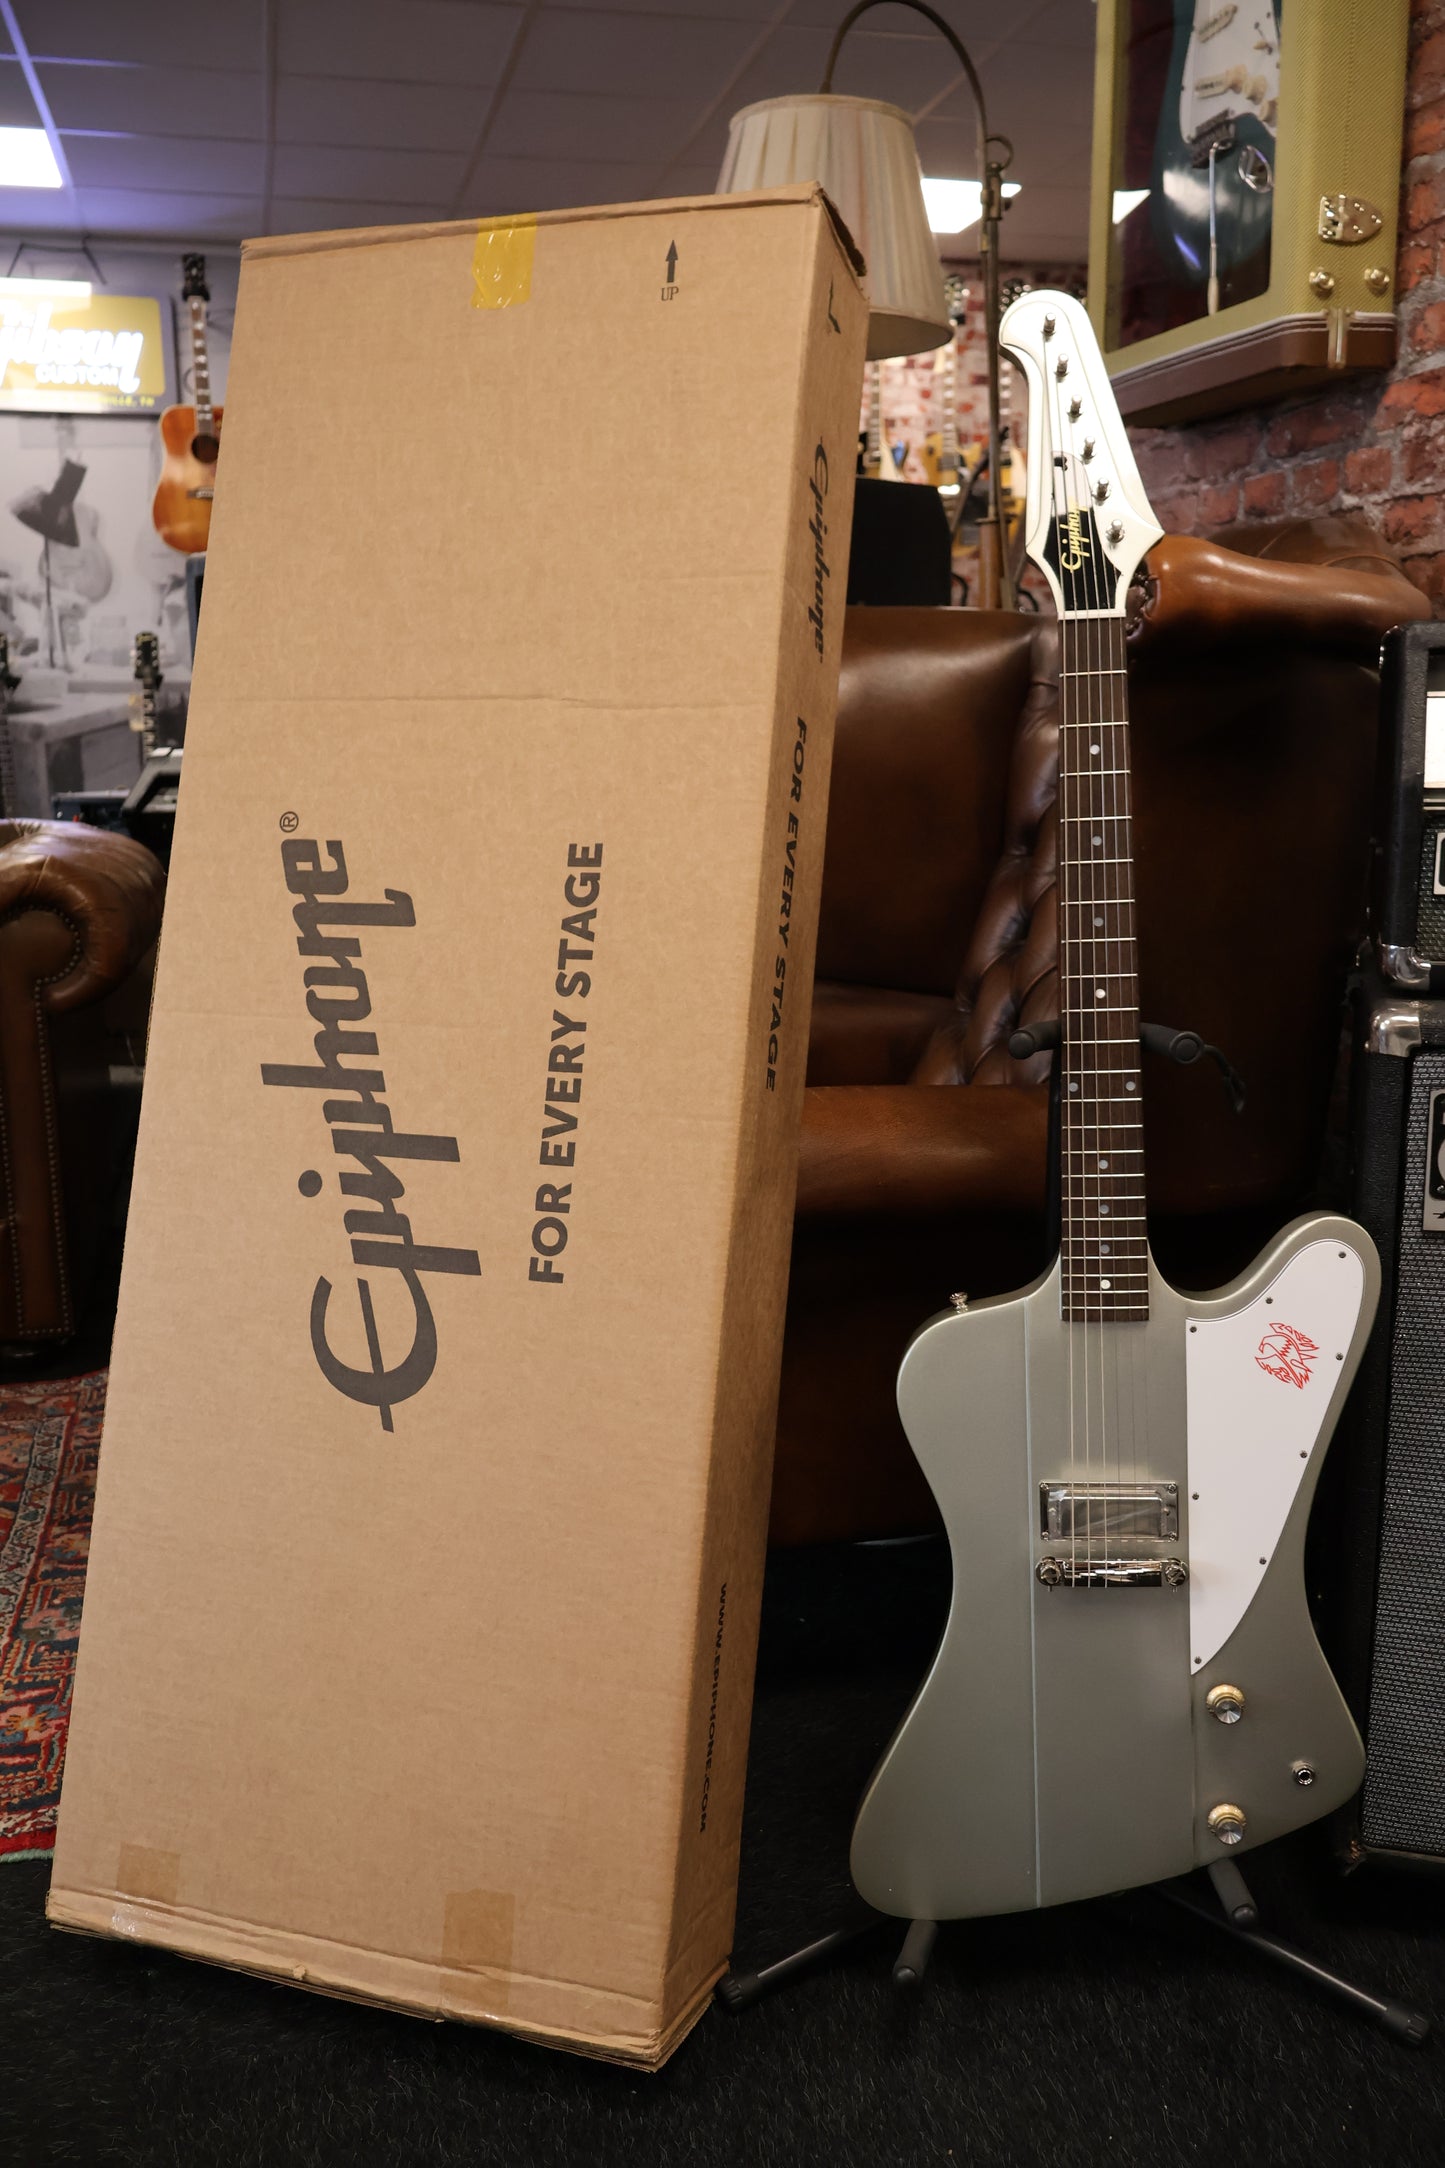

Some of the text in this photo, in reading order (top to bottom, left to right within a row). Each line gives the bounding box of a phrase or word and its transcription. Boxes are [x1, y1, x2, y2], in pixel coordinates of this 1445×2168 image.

[661, 286, 680, 301] UP
[1059, 495, 1090, 574] Epiphon
[765, 716, 807, 1093] FOR EVERY STAGE
[528, 843, 604, 1285] FOR EVERY STAGE
[699, 1582, 728, 1834] WWW.EPIPHONE.COM
